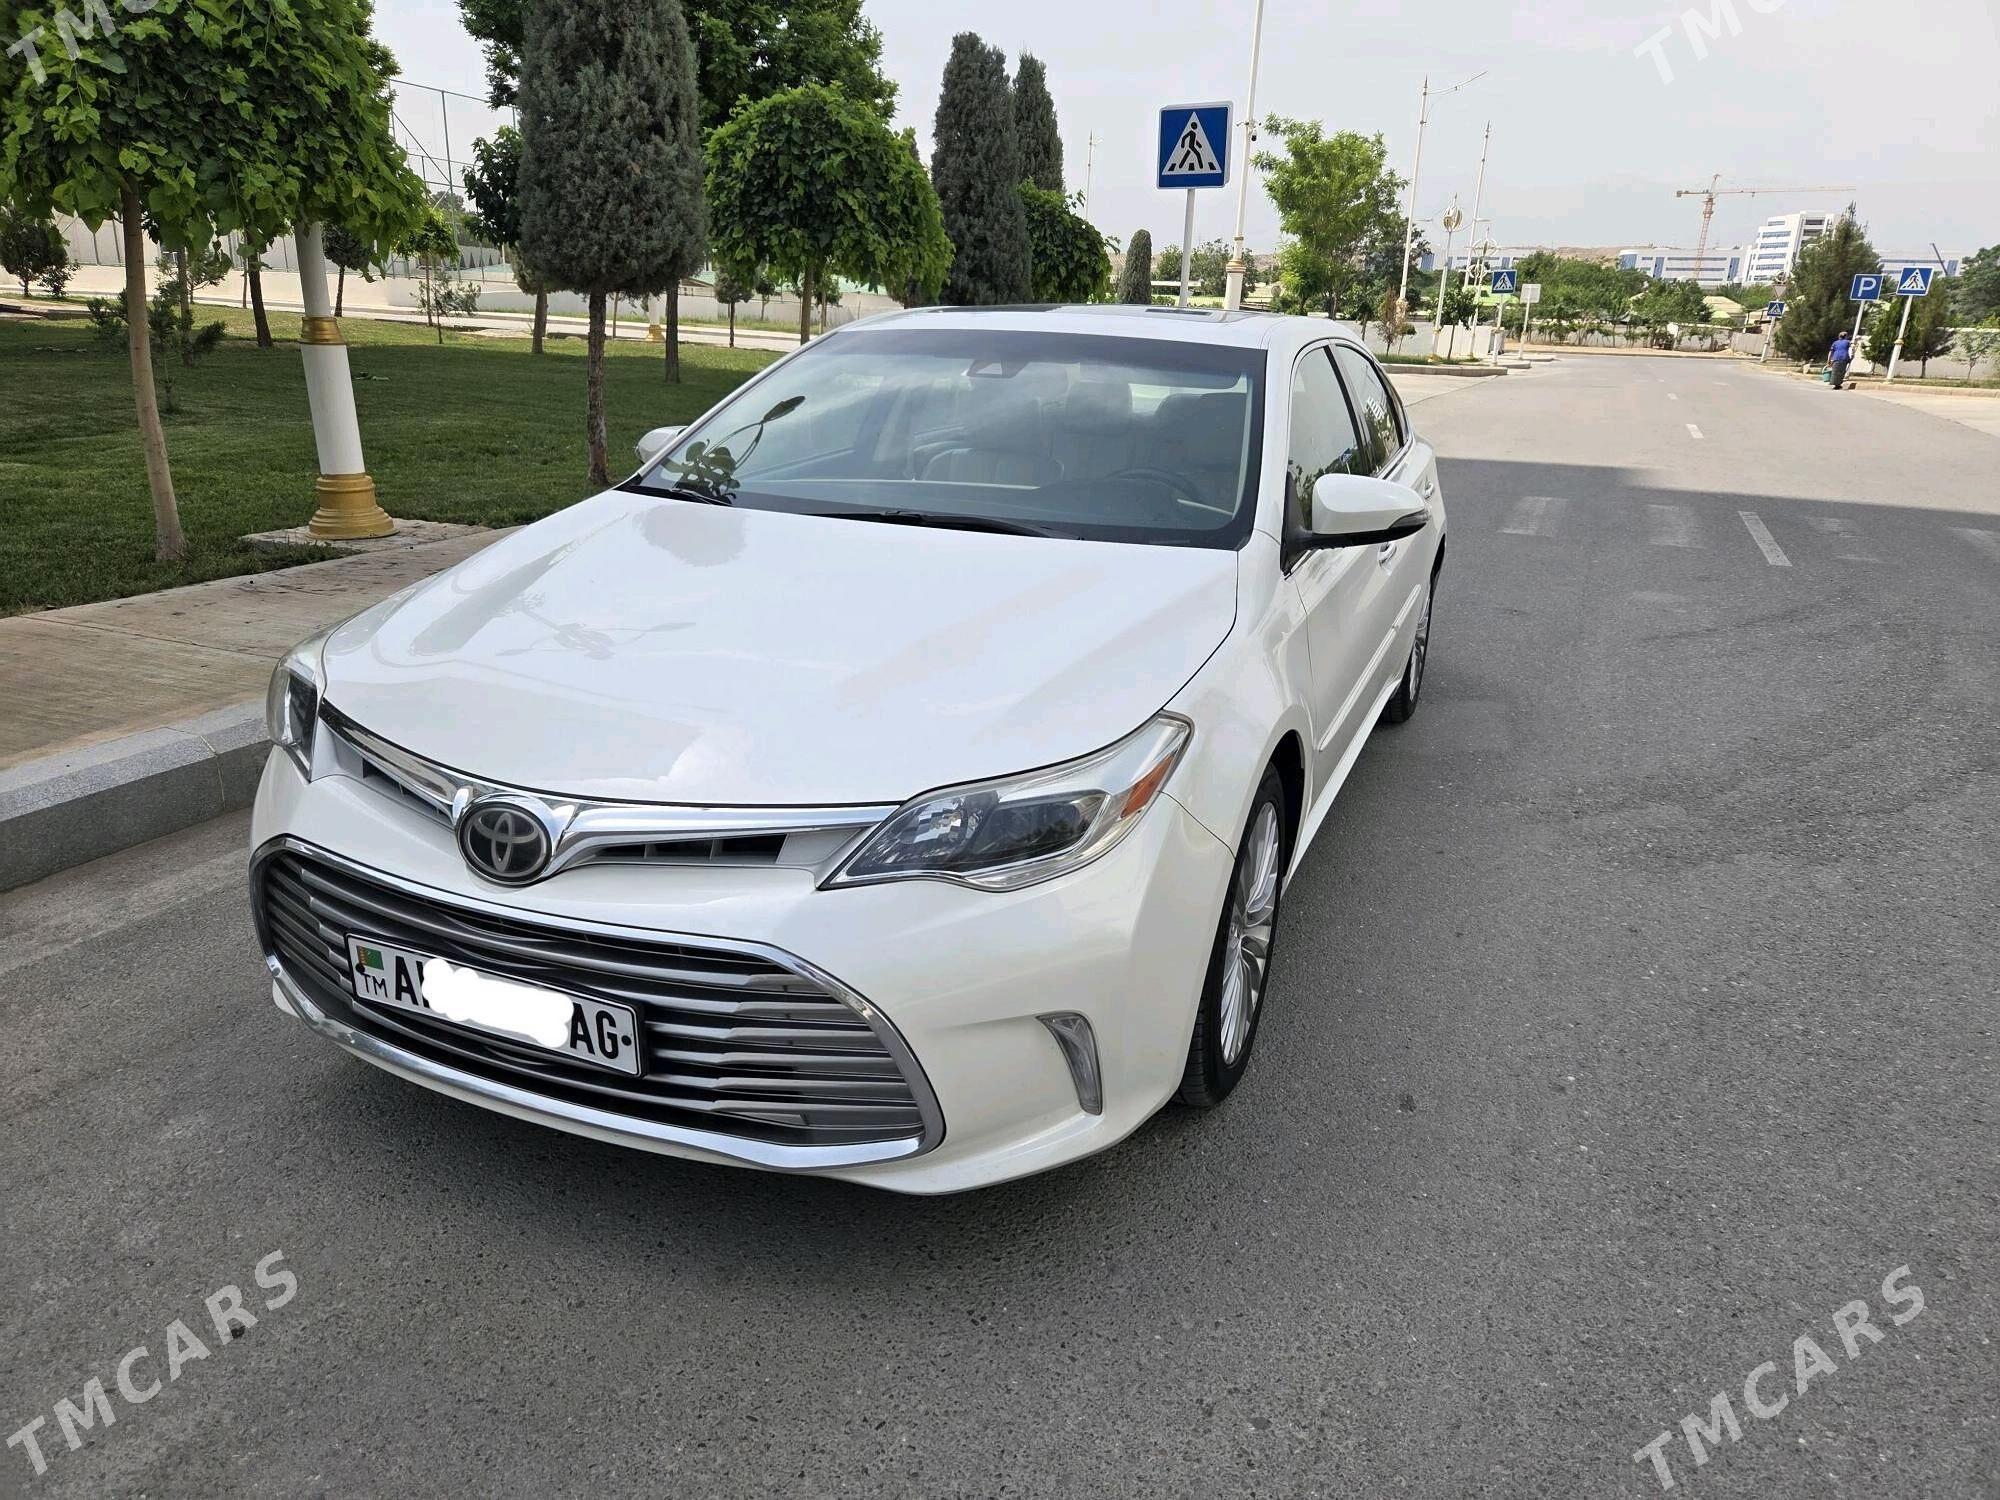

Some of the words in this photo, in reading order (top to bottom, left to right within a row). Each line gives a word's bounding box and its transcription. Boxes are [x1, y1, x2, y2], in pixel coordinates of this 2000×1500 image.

[1858, 278, 1877, 297] P
[360, 972, 388, 998] TM
[570, 1003, 619, 1060] AG
